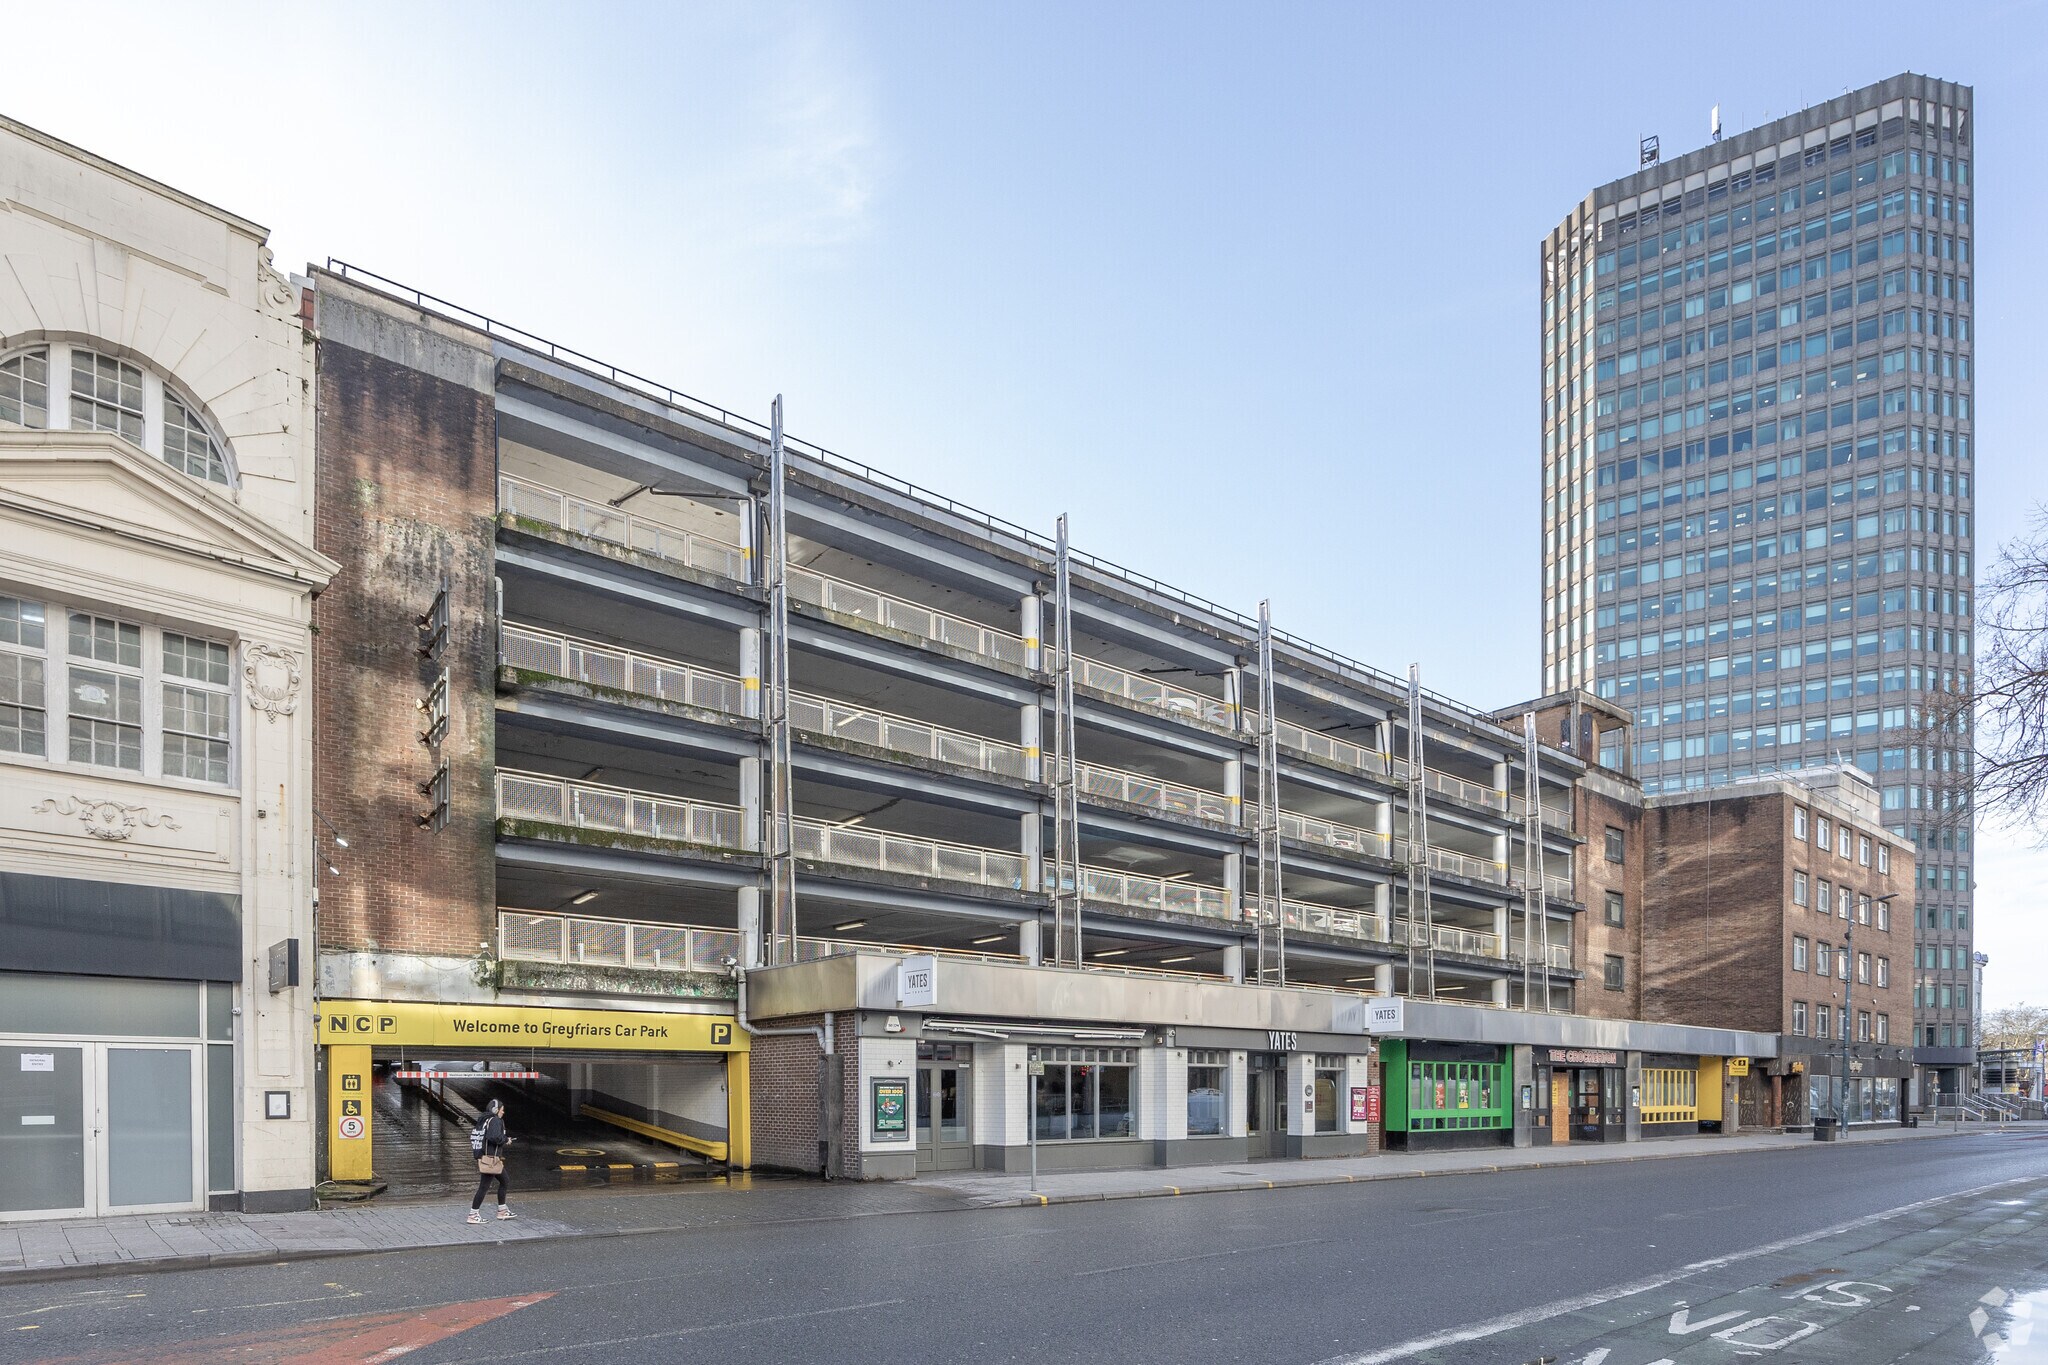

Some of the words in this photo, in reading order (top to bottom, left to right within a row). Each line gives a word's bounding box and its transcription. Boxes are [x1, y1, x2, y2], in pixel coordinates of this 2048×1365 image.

[907, 973, 928, 989] YATES
[1374, 1009, 1396, 1020] YATES
[453, 1019, 520, 1034] Welcome
[524, 1022, 538, 1034] to
[542, 1021, 612, 1039] Greyfriars
[615, 1024, 637, 1037] Car
[640, 1025, 668, 1038] Park
[714, 1025, 728, 1043] P
[1268, 1031, 1297, 1051] YATES
[1548, 1049, 1566, 1061] THE
[348, 1121, 356, 1131] 5
